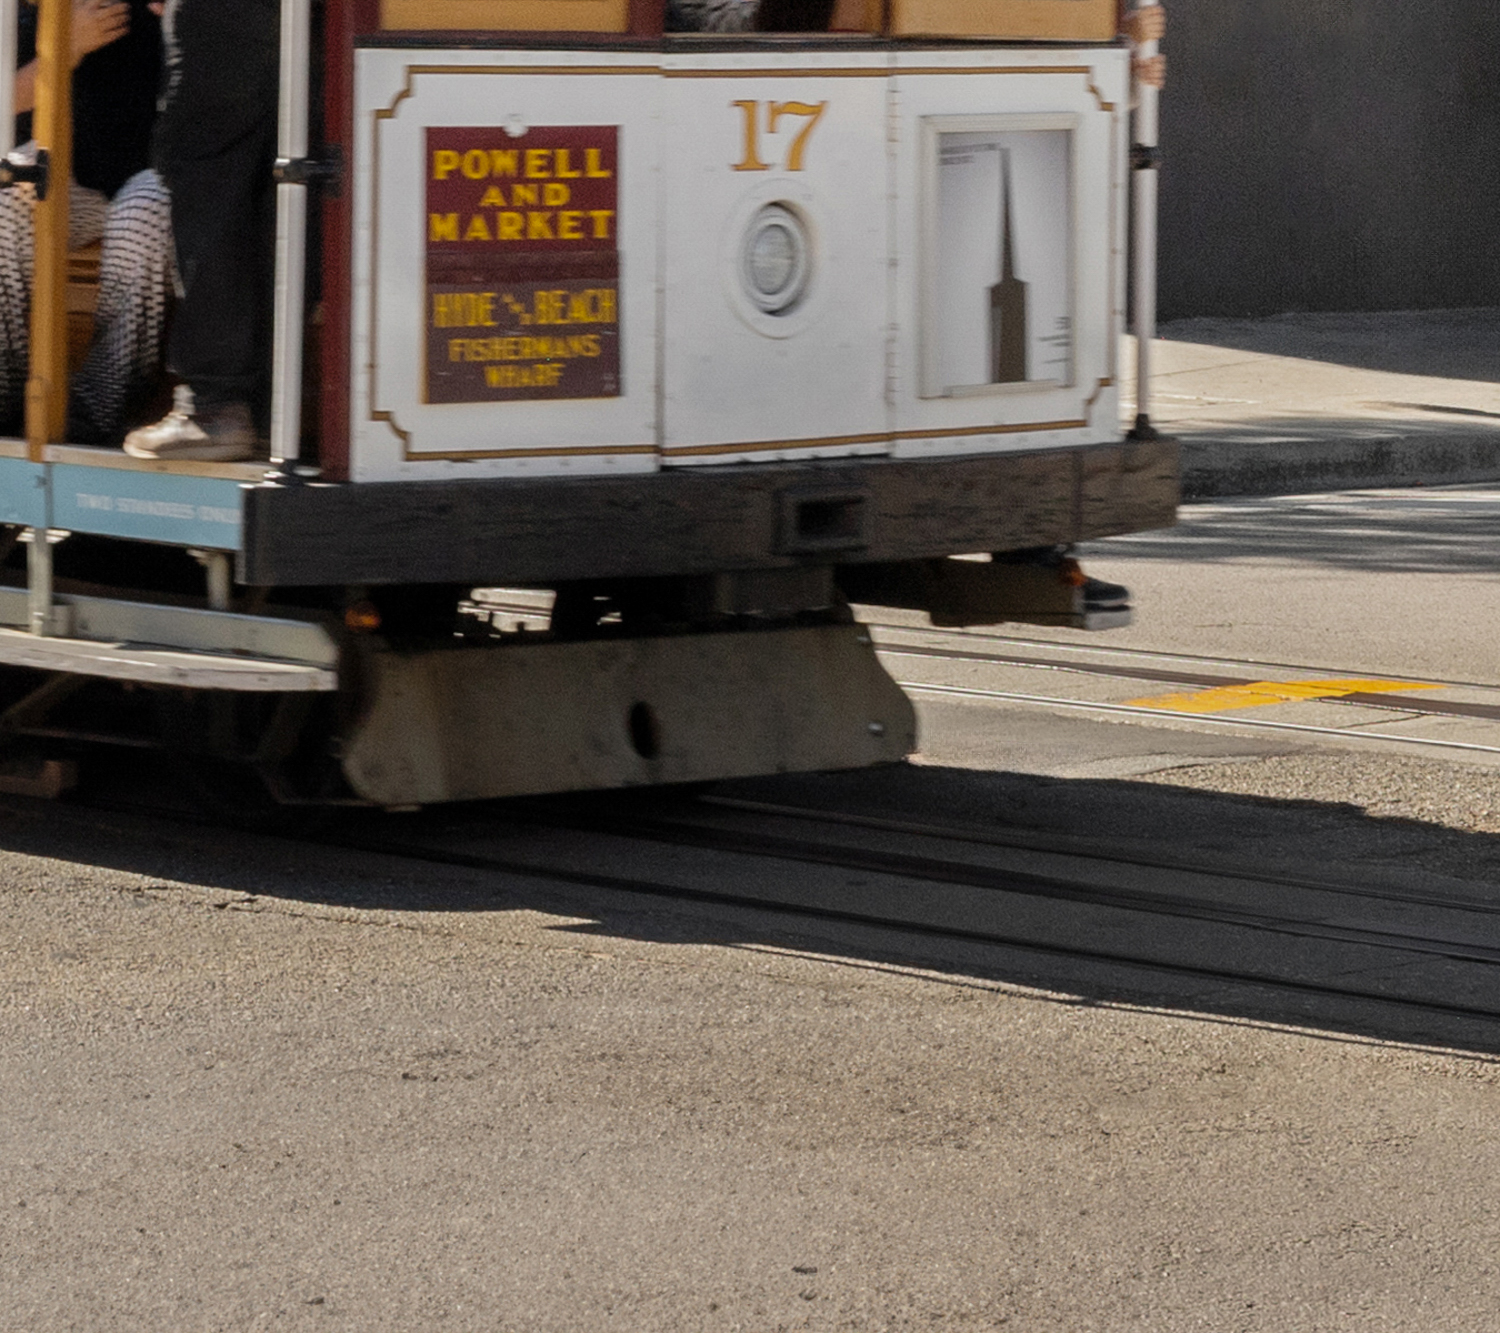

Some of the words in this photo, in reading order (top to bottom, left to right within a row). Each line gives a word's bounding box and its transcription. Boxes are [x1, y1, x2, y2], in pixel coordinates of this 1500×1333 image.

[728, 99, 828, 172] 17
[432, 147, 612, 180] POWELL
[479, 183, 572, 207] AND
[429, 209, 614, 242] MARKET
[533, 288, 617, 324] BEACH
[448, 334, 601, 362] FISHERMANS
